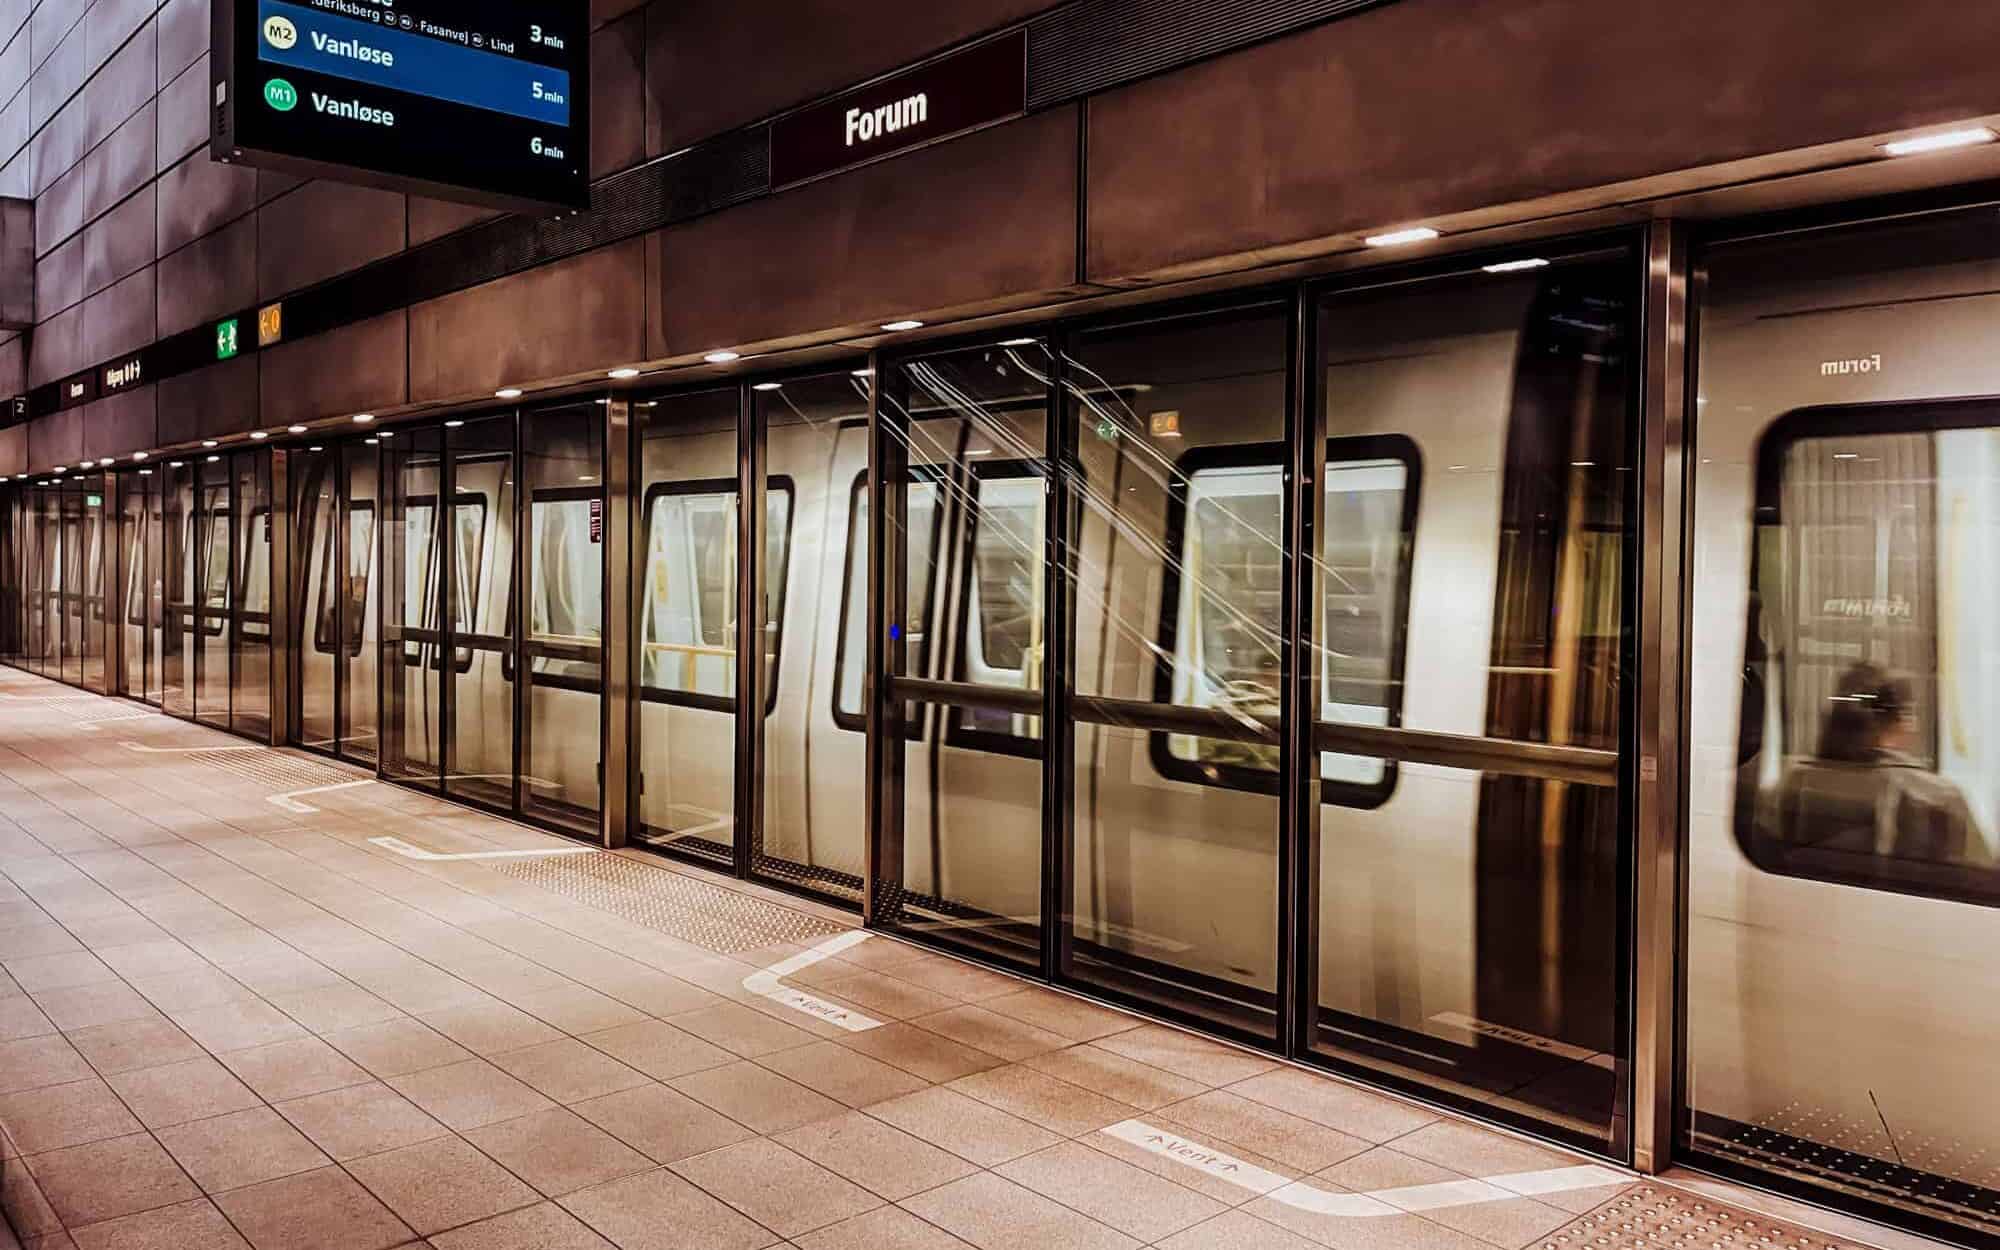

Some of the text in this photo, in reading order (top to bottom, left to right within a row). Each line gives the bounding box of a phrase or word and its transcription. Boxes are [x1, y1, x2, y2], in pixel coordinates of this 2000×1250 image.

[311, 0, 380, 22] deriksberg
[420, 20, 469, 45] Fasanvej
[491, 38, 514, 53] Lind
[530, 25, 564, 50] 3 min
[267, 25, 564, 105] M2 Vanløse 5 min
[269, 87, 564, 160] M1 Vanløse 6 min
[845, 92, 928, 146] Forum
[1167, 1141, 1217, 1165] Vent
